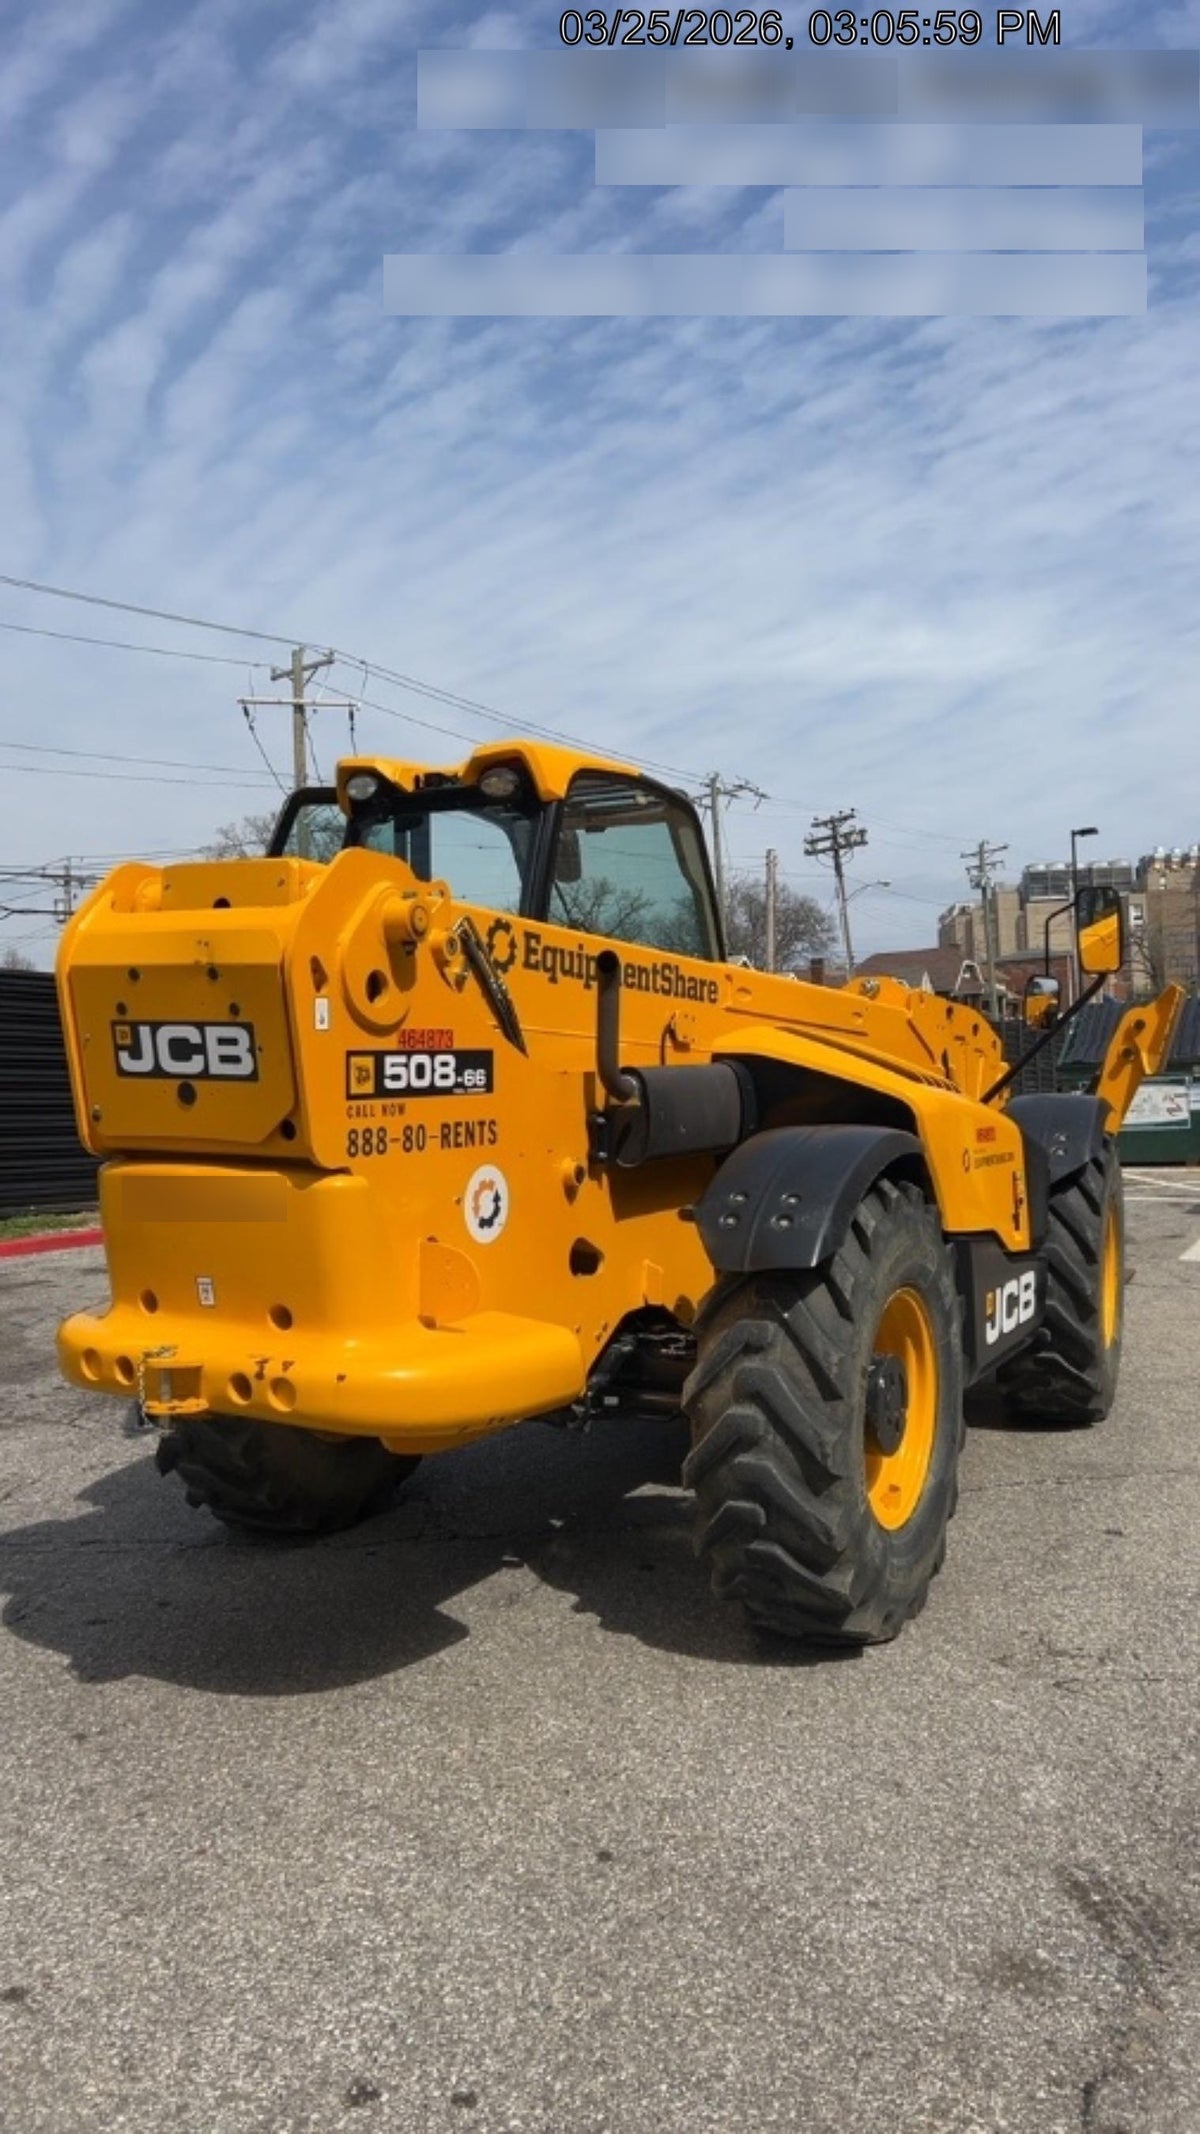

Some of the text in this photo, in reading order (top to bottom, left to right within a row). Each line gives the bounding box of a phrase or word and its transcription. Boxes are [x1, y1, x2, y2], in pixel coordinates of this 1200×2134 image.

[523, 931, 719, 1003] EquipentShare
[117, 1024, 255, 1075] JCB
[398, 1029, 454, 1048] 464873
[383, 1054, 487, 1089] 508-66
[346, 1102, 407, 1119] CALL NOW
[347, 1119, 497, 1158] 888-80-RENTS
[986, 1270, 1035, 1345] JCB
